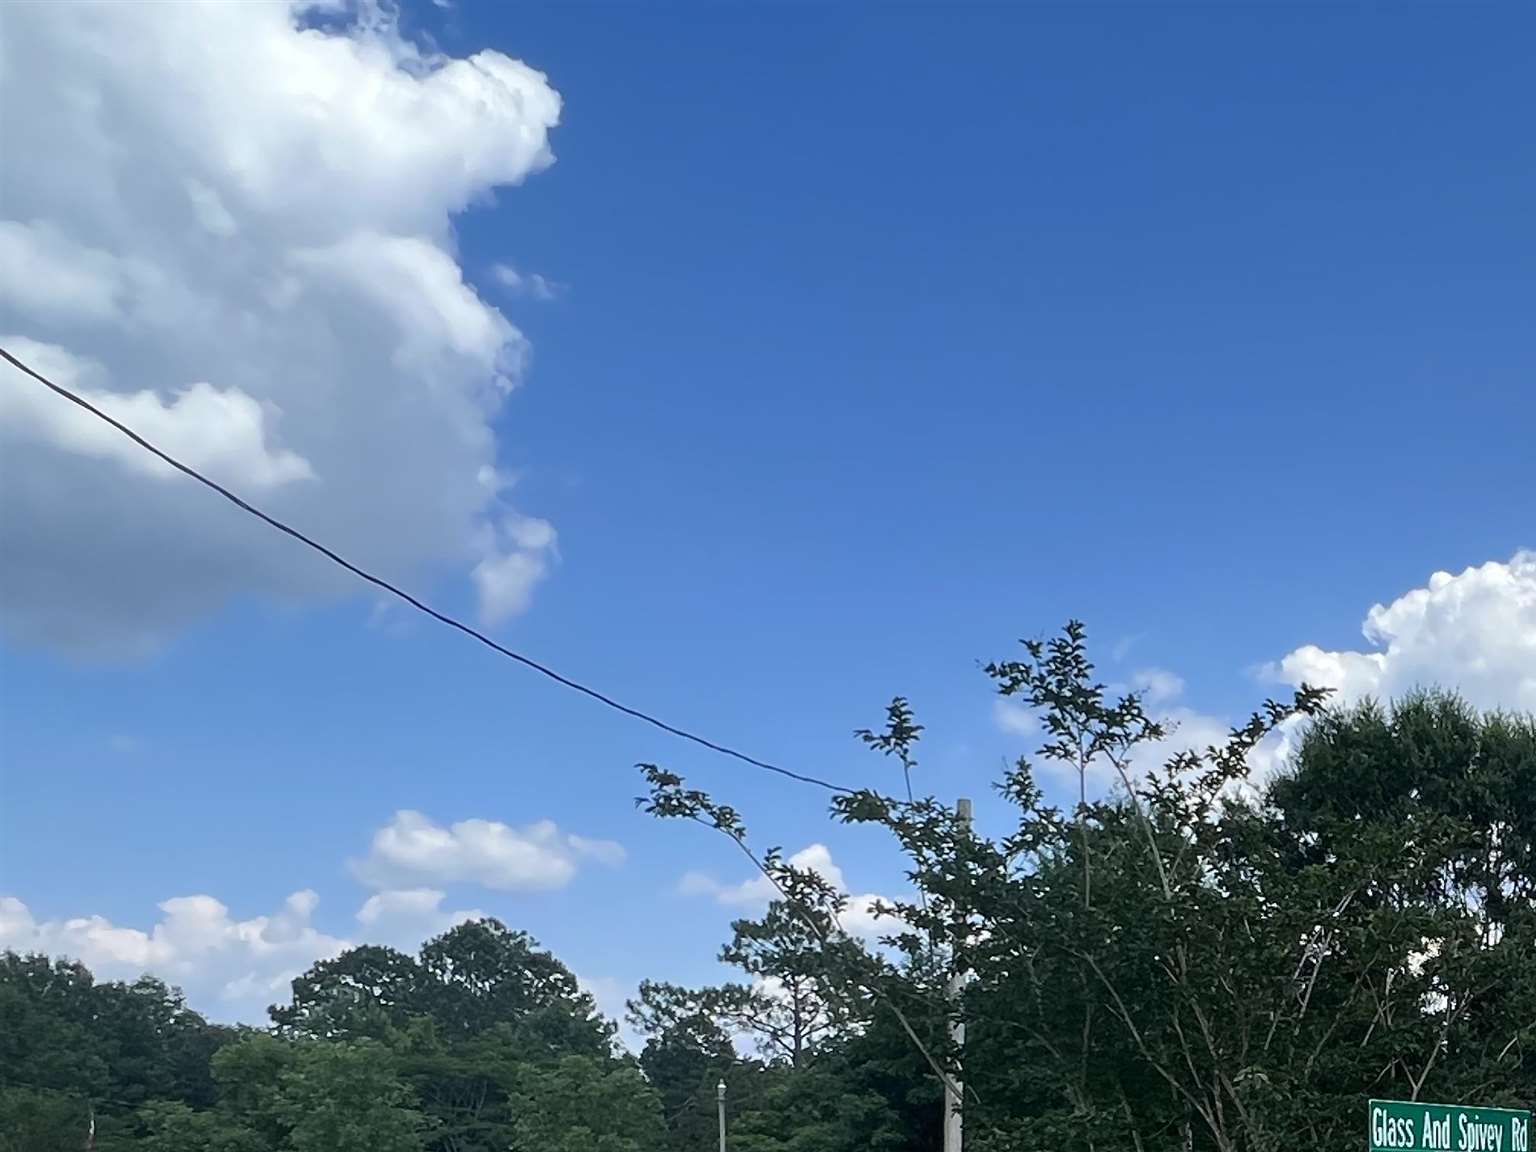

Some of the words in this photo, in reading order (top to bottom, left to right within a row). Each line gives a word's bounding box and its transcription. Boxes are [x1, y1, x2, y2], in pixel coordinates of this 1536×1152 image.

[1372, 1108, 1414, 1148] Glass
[1422, 1111, 1450, 1149] And
[1512, 1117, 1528, 1152] Rd
